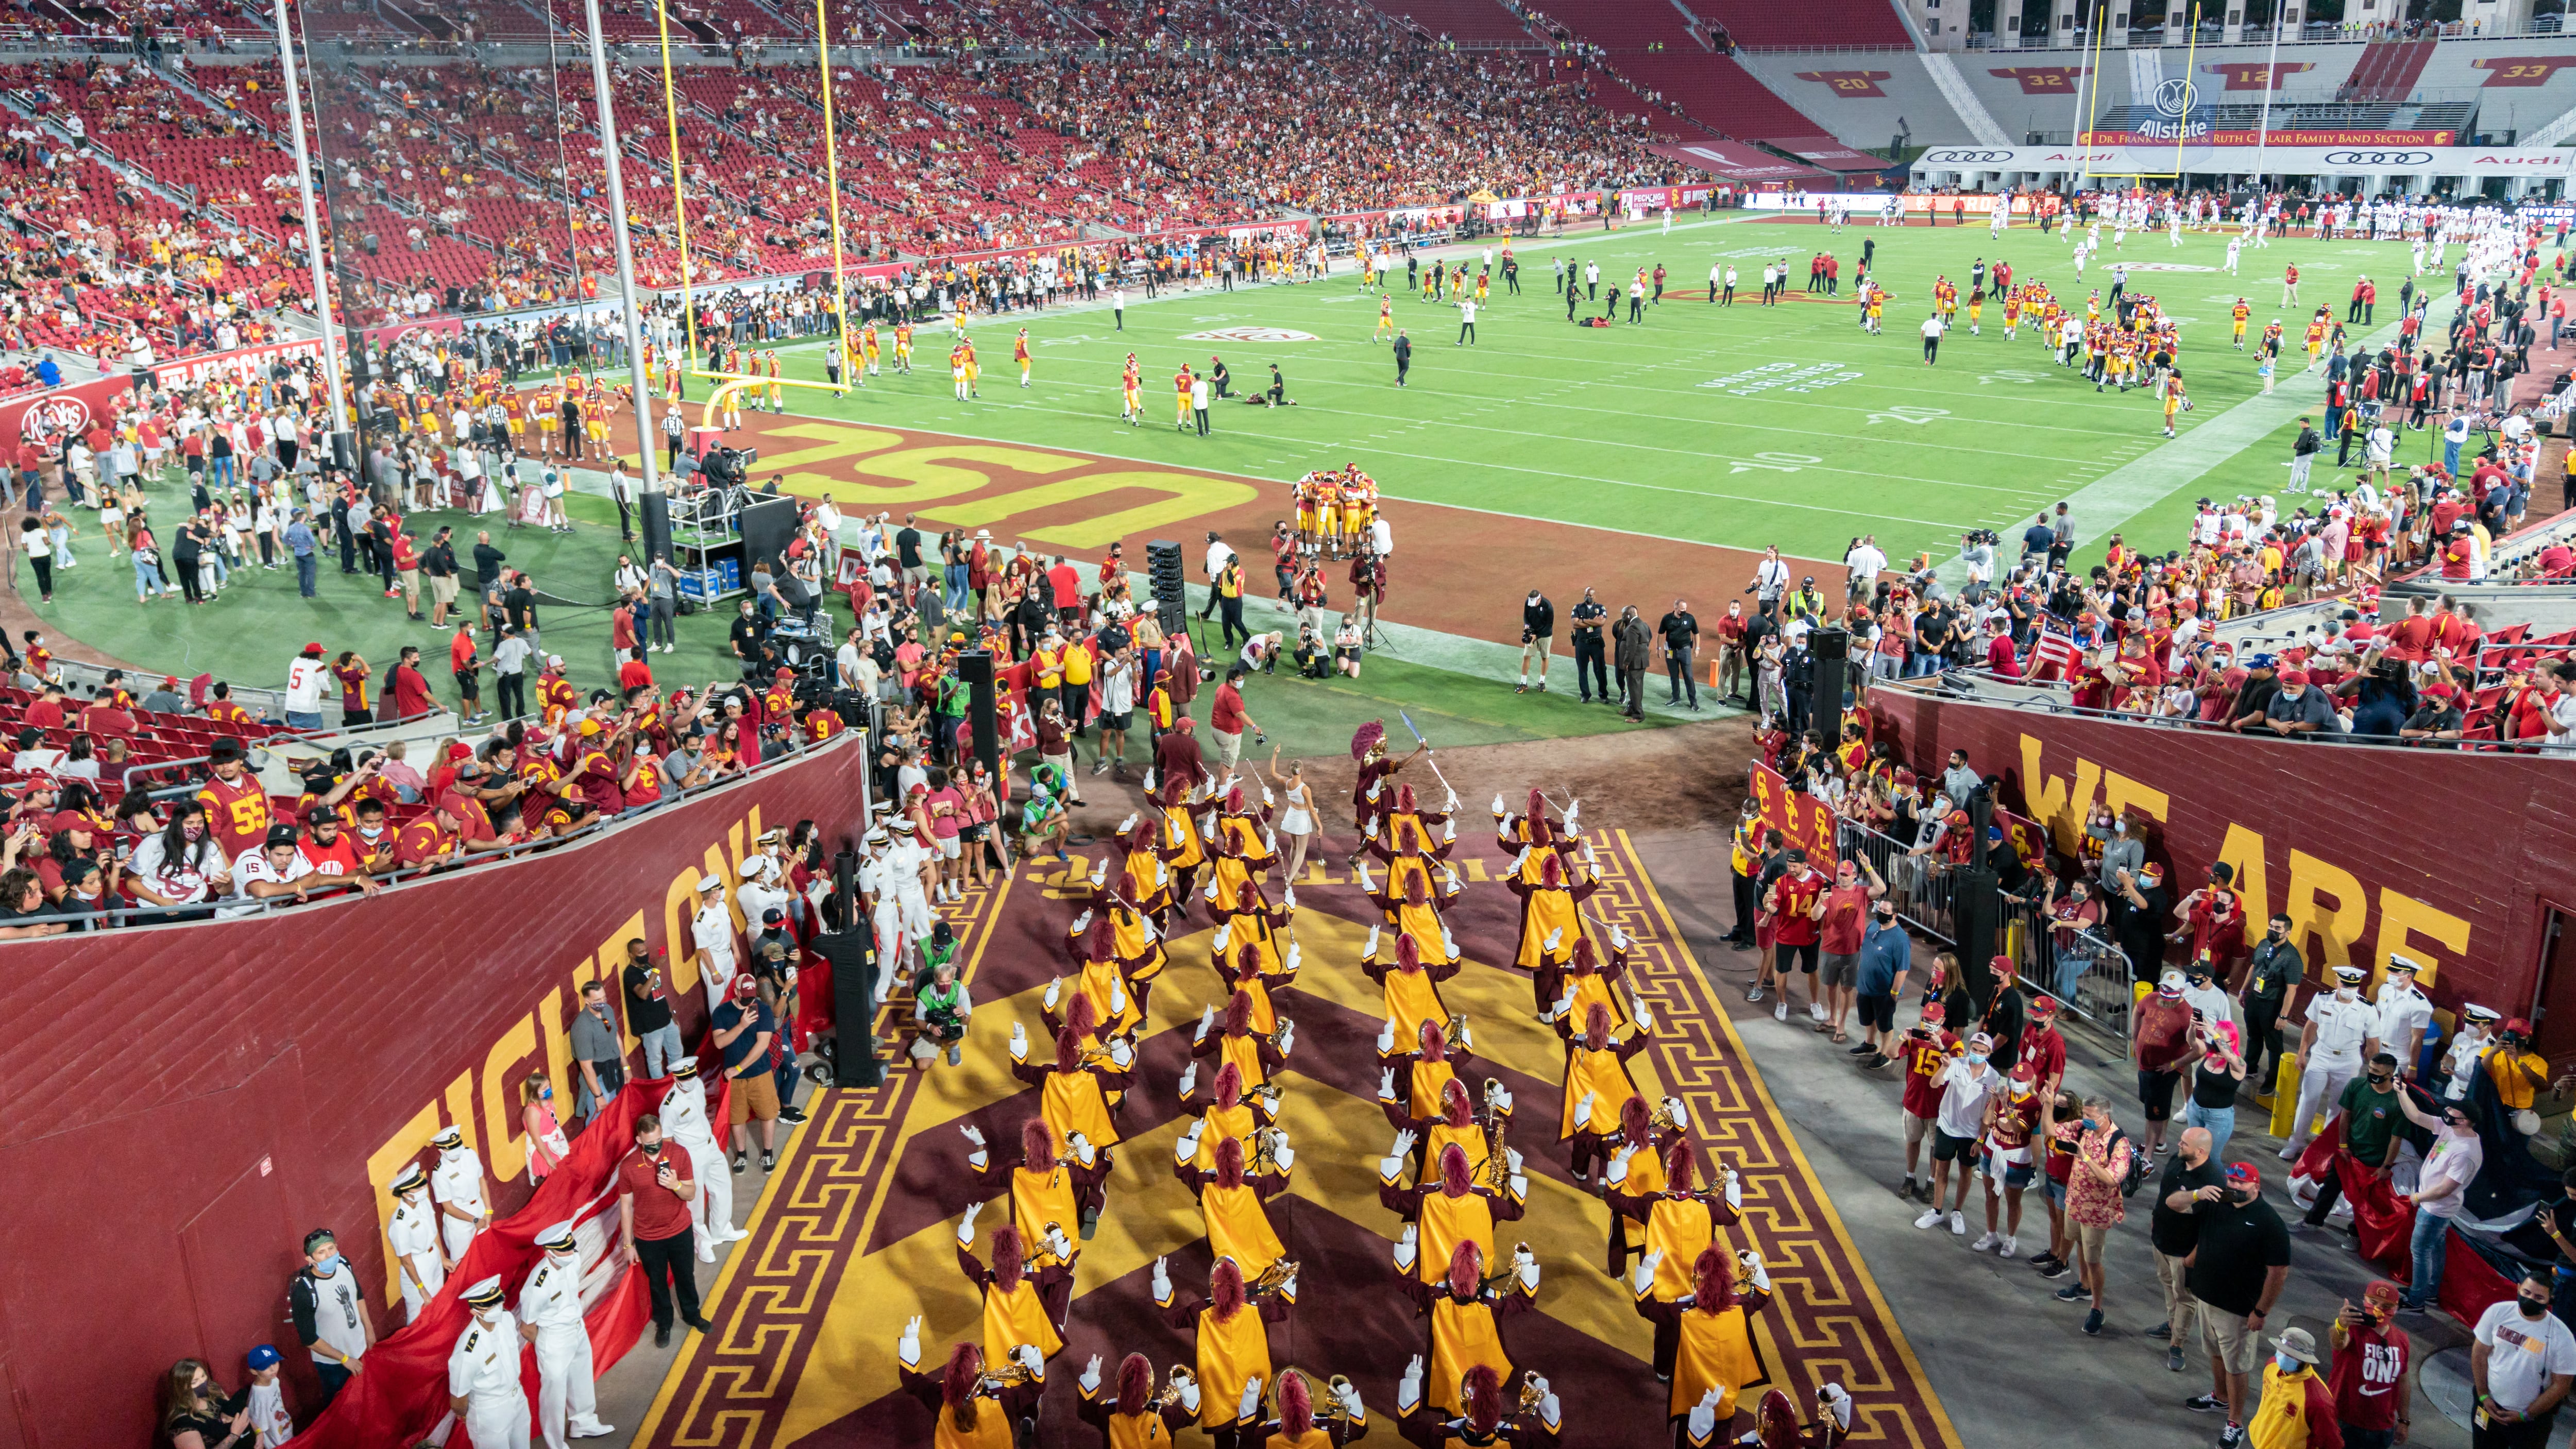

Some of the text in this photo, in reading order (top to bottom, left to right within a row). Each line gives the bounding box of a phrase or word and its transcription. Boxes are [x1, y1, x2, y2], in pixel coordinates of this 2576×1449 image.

[2240, 71, 2269, 82] 12
[2502, 65, 2548, 78] 33
[1834, 79, 1869, 90] 20
[2030, 75, 2063, 86] 32
[2136, 120, 2207, 139] Allstate
[2099, 134, 2115, 143] DR.
[2119, 134, 2151, 143] FRANK
[2201, 134, 2209, 143] &
[2213, 134, 2243, 143] RUTH
[2246, 134, 2257, 143] C.
[2296, 134, 2335, 144] FAMILY
[2339, 134, 2370, 143] BAND
[2374, 133, 2424, 144] SECTION
[2518, 208, 2575, 216] UNITED
[1872, 293, 1884, 303] 99
[1946, 291, 1952, 299] 9
[2007, 301, 2019, 309] 57
[2046, 308, 2057, 316] 35
[2234, 308, 2247, 318] 52
[899, 331, 908, 340] 10
[2309, 325, 2320, 336] 36
[478, 376, 492, 385] 57
[1695, 362, 1799, 388] UNITED
[1727, 363, 1846, 396] AIRLINES
[1179, 379, 1187, 390] 7
[1785, 372, 1865, 393] FIELD
[420, 397, 429, 408] 0
[537, 397, 552, 408] 75
[492, 405, 500, 415] C
[1866, 405, 1952, 425] 20
[668, 419, 675, 430] R
[1729, 452, 1823, 474] 10
[1318, 487, 1336, 503] 29
[2353, 524, 2362, 535] 6
[290, 668, 304, 690] 5
[770, 702, 779, 711] 15
[816, 720, 828, 739] 9
[601, 763, 612, 772] 1
[931, 800, 953, 811] TROJANS
[1785, 789, 1799, 831] SC
[229, 792, 265, 836] 55
[553, 815, 566, 824] 55
[1815, 806, 1830, 850] SC
[416, 836, 429, 850] 7
[245, 863, 260, 874] 15
[1789, 893, 1814, 917] 14
[2208, 822, 2471, 1045] ARE
[1913, 1047, 1942, 1077] 15
[367, 908, 645, 1310] FIGHT
[2362, 1357, 2401, 1384] ON!
